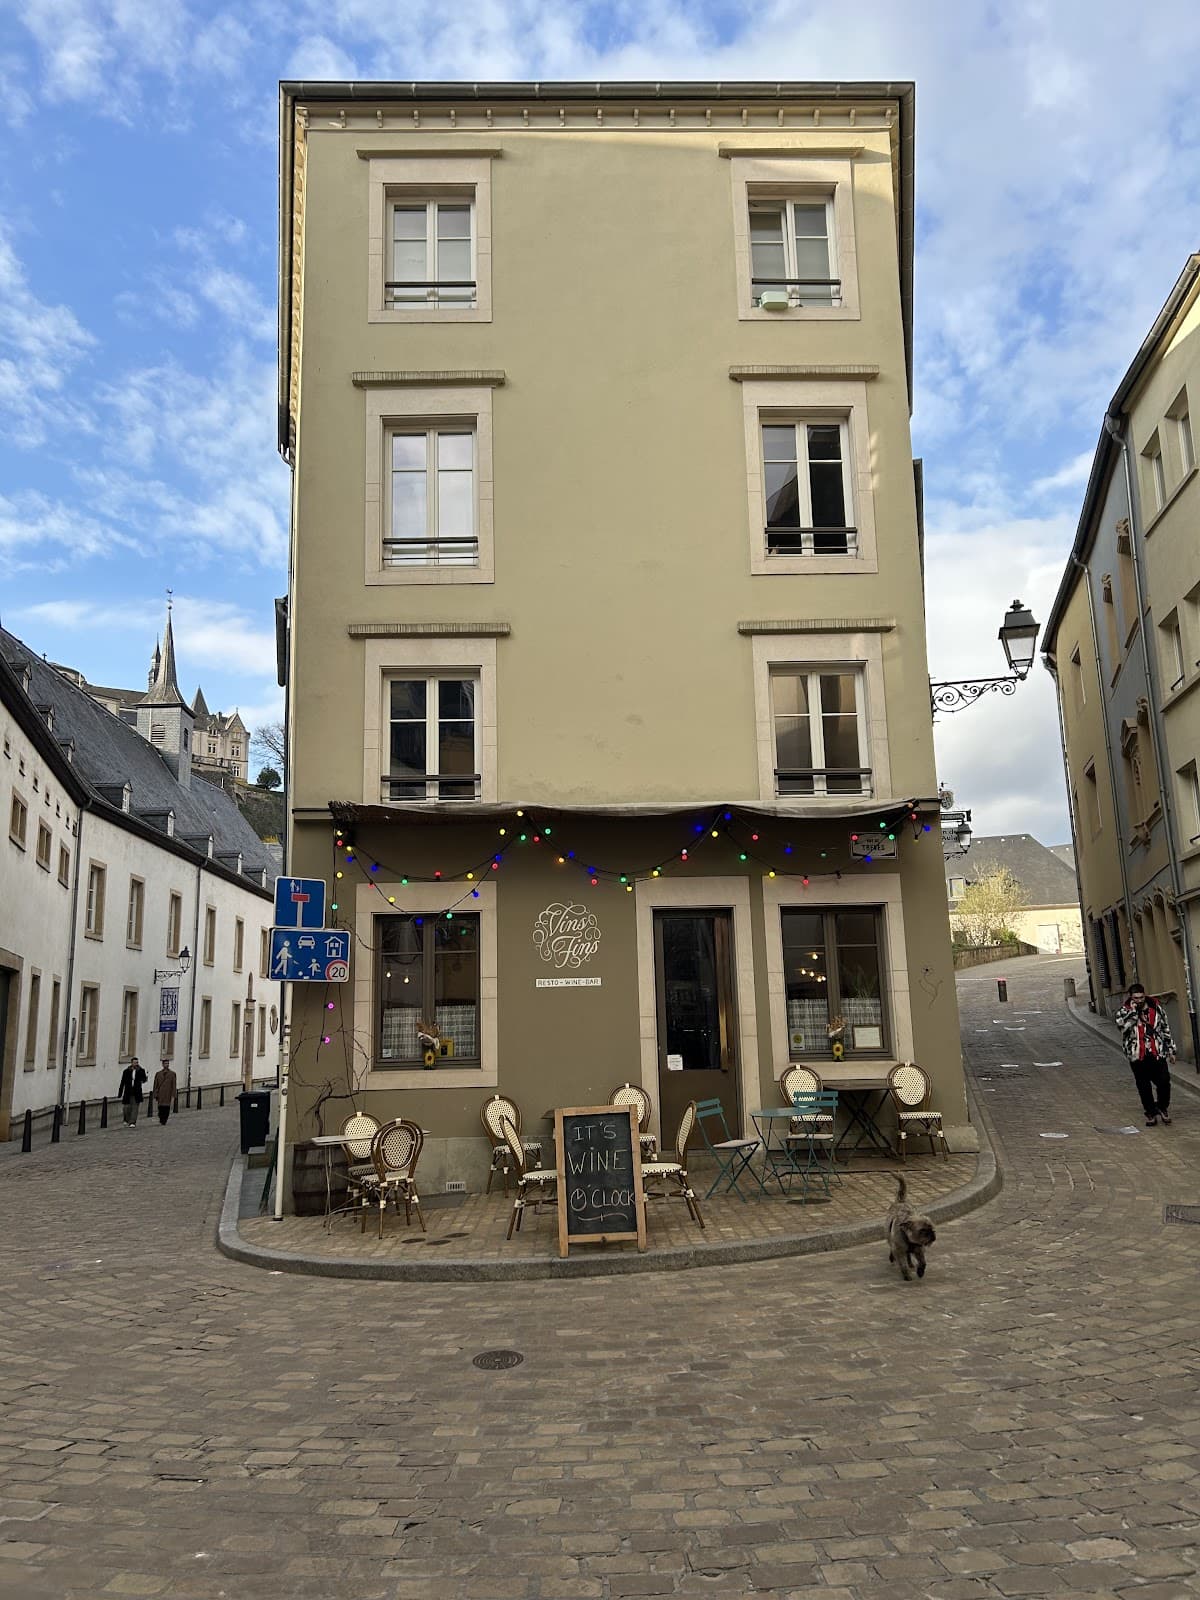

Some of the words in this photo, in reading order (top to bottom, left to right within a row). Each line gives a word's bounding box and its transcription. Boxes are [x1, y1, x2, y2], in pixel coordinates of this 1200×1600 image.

[539, 903, 588, 937] Vins
[551, 932, 600, 968] Fins
[332, 967, 346, 978] 20
[573, 1121, 617, 1141] IT'S
